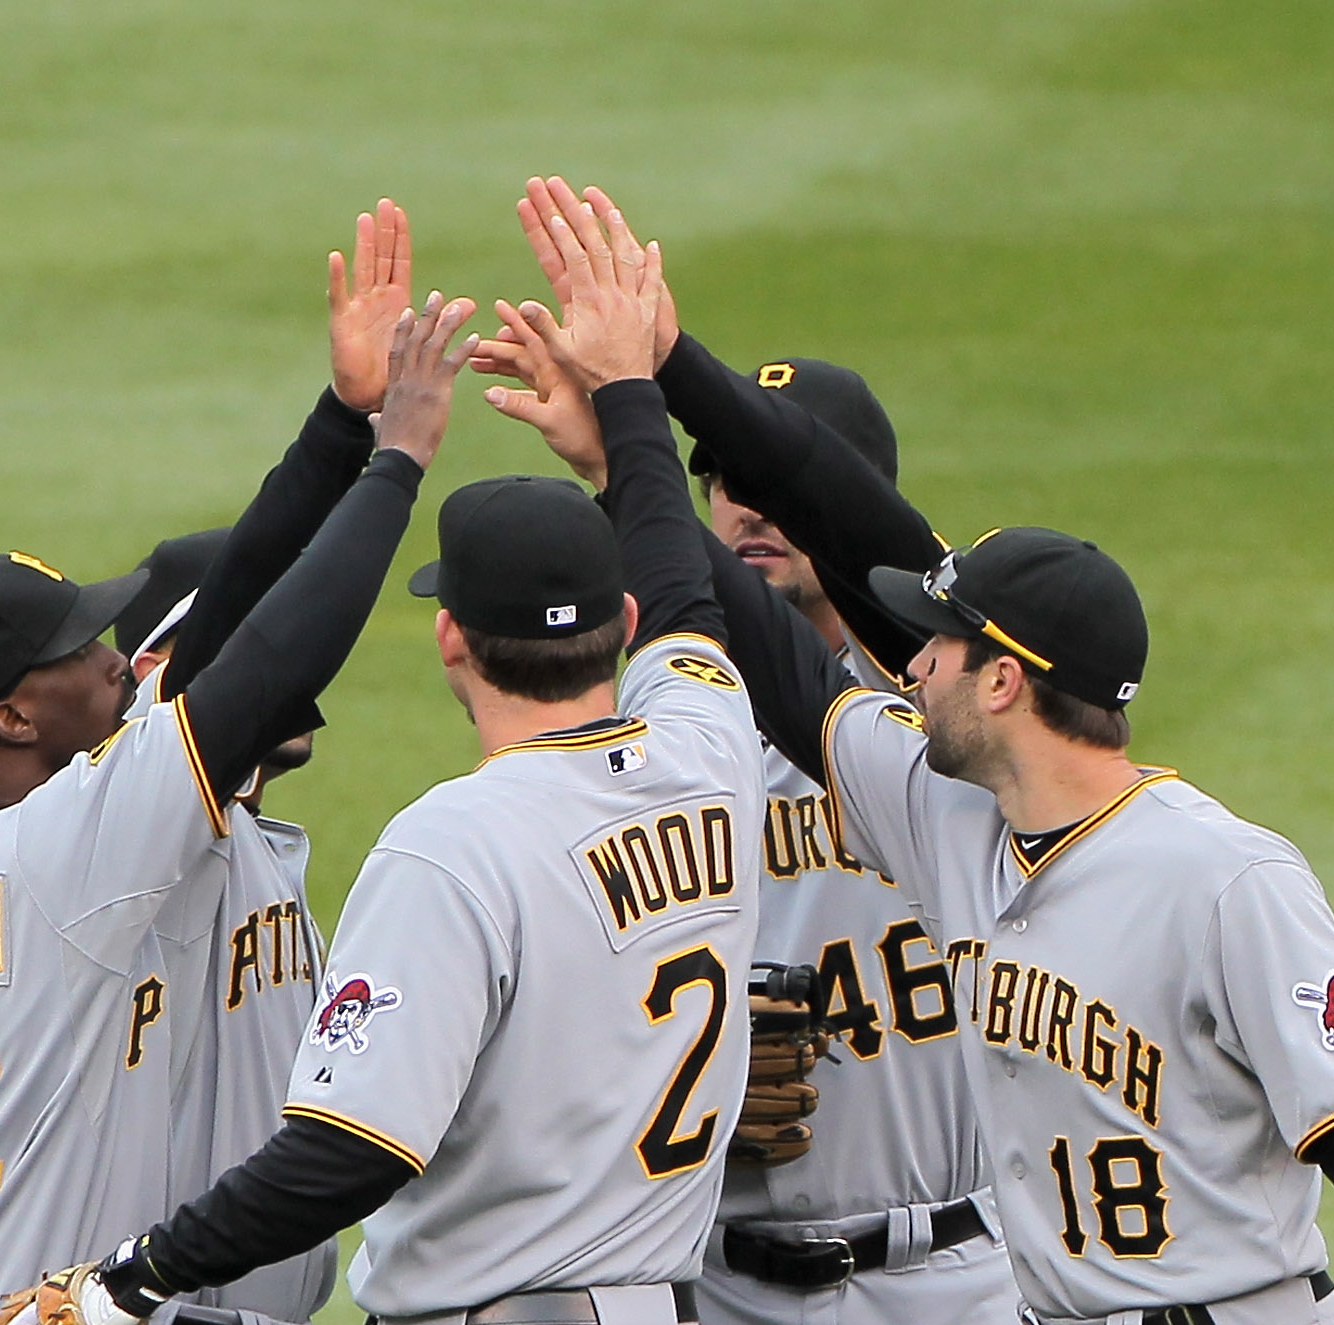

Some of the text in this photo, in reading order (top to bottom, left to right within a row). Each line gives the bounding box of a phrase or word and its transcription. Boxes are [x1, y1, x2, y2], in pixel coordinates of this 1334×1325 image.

[586, 806, 734, 931] WOOD
[817, 916, 959, 1061] 46
[633, 941, 729, 1180] 2
[1047, 1135, 1175, 1259] 18
